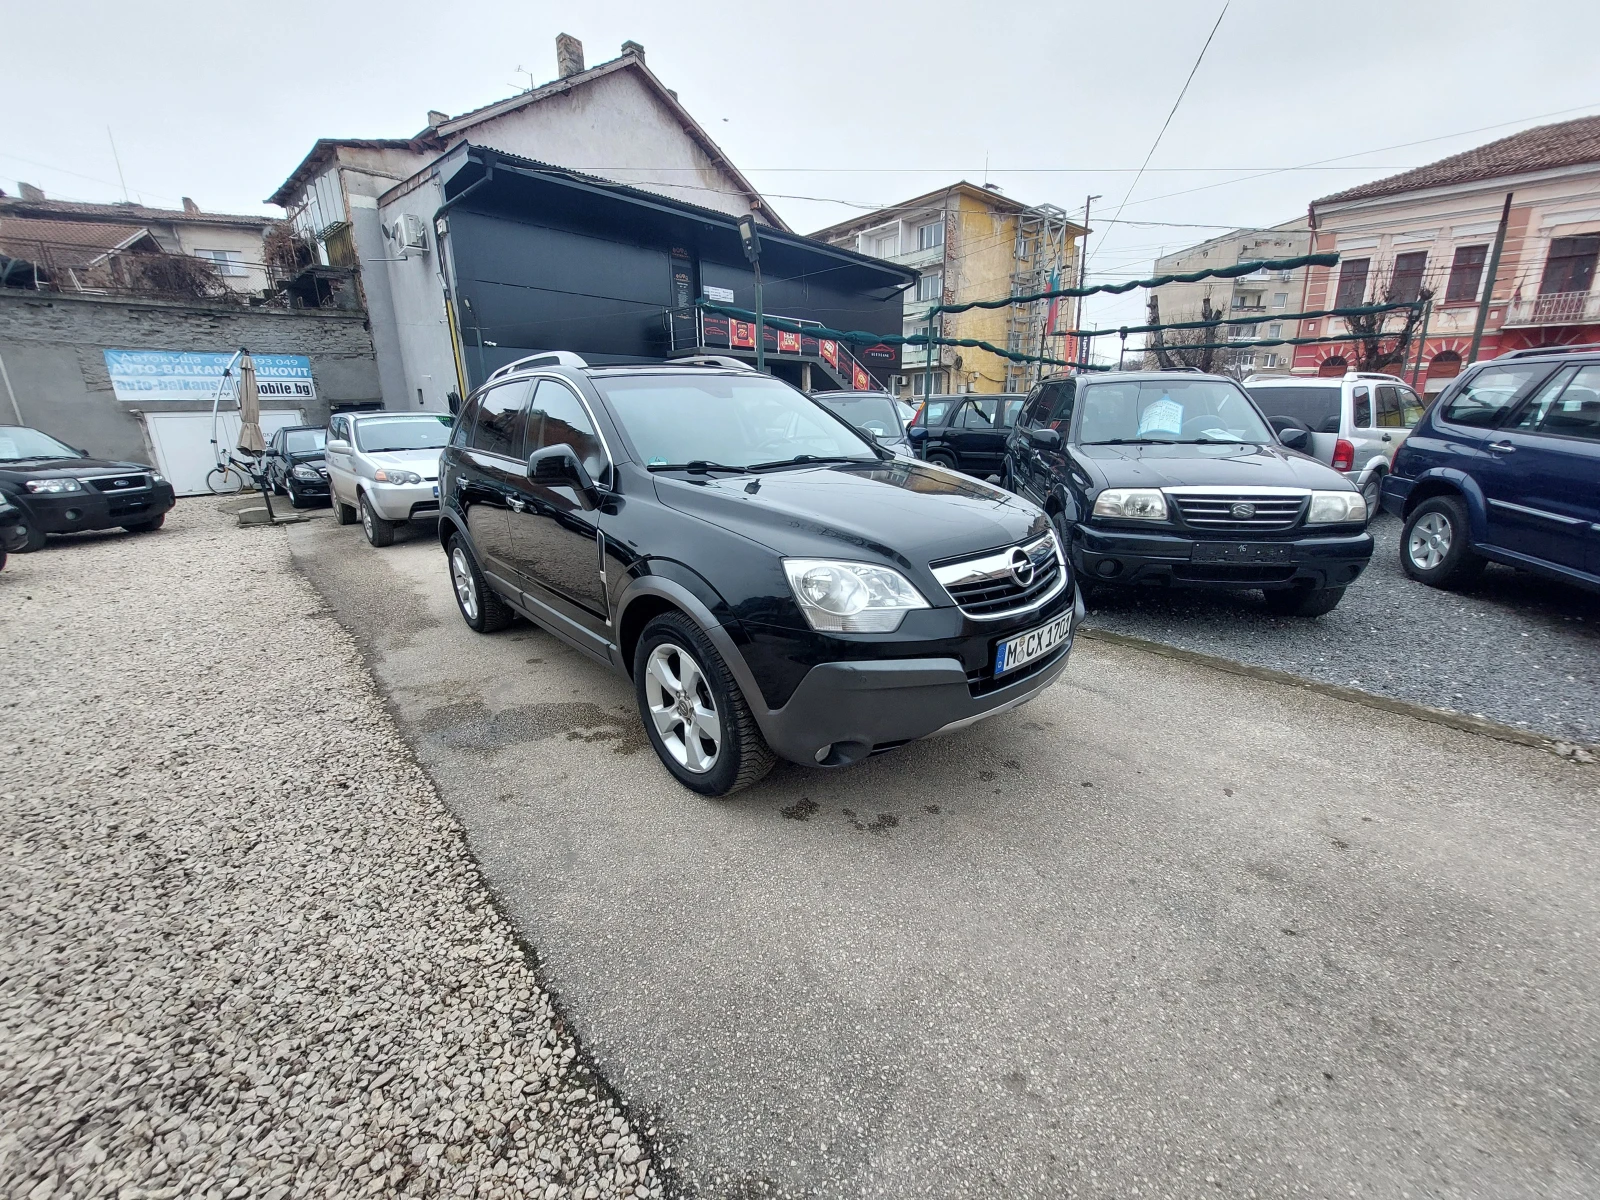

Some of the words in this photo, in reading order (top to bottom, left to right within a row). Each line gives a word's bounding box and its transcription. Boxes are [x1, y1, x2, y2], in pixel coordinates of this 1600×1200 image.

[122, 353, 201, 364] Автокъща
[254, 366, 309, 376] LUKOVIT
[1238, 544, 1248, 552] 16
[1006, 641, 1018, 667] M
[1026, 630, 1044, 657] CX
[1045, 615, 1070, 647] 1701
